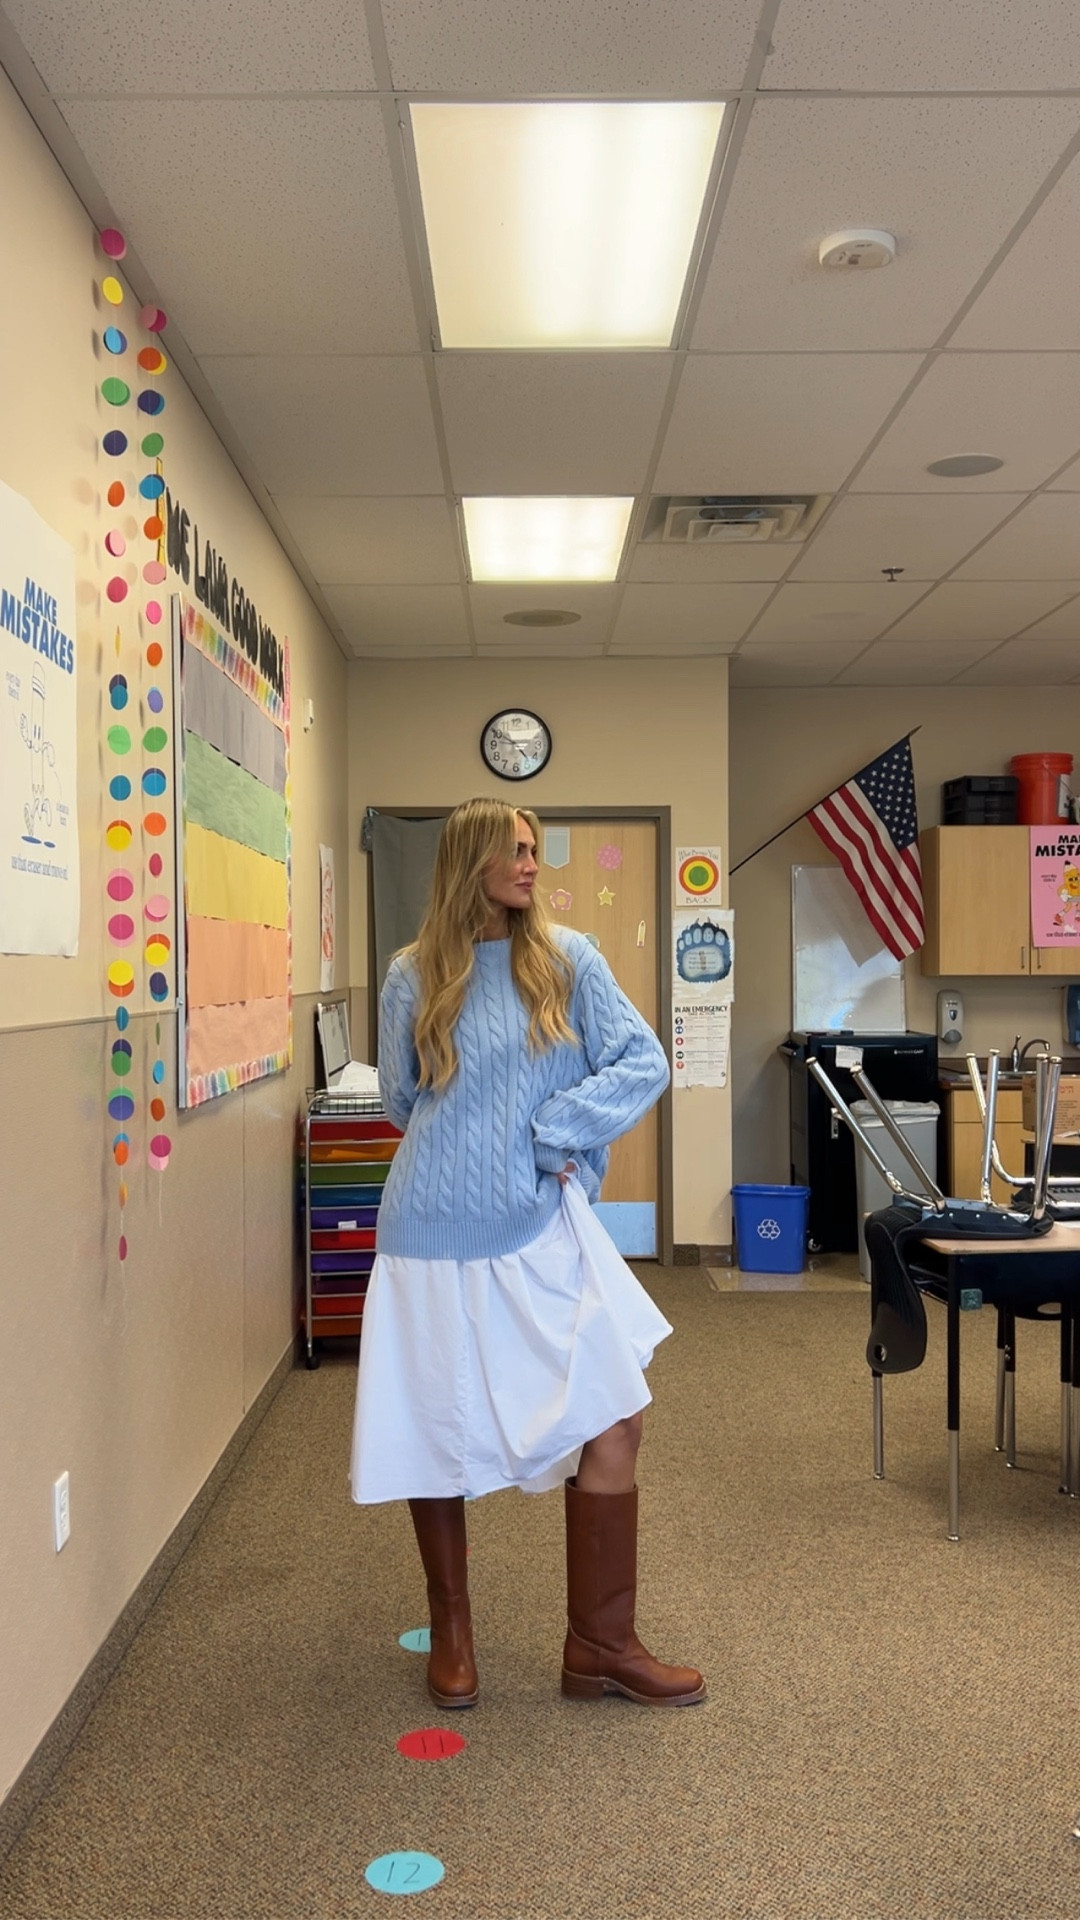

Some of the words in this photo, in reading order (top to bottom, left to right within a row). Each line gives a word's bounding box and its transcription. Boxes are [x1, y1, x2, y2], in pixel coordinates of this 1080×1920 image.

[24, 576, 57, 626] MAKE
[0, 588, 74, 674] MISTAKES
[511, 718, 522, 728] 12
[490, 740, 498, 750] 9
[534, 741, 542, 750] 3
[493, 751, 501, 761] 8
[532, 752, 539, 761] 4
[501, 759, 509, 770] 7
[512, 762, 520, 772] 6
[1058, 834, 1080, 844] MA
[421, 1735, 444, 1754] 11
[387, 1860, 420, 1884] 12
